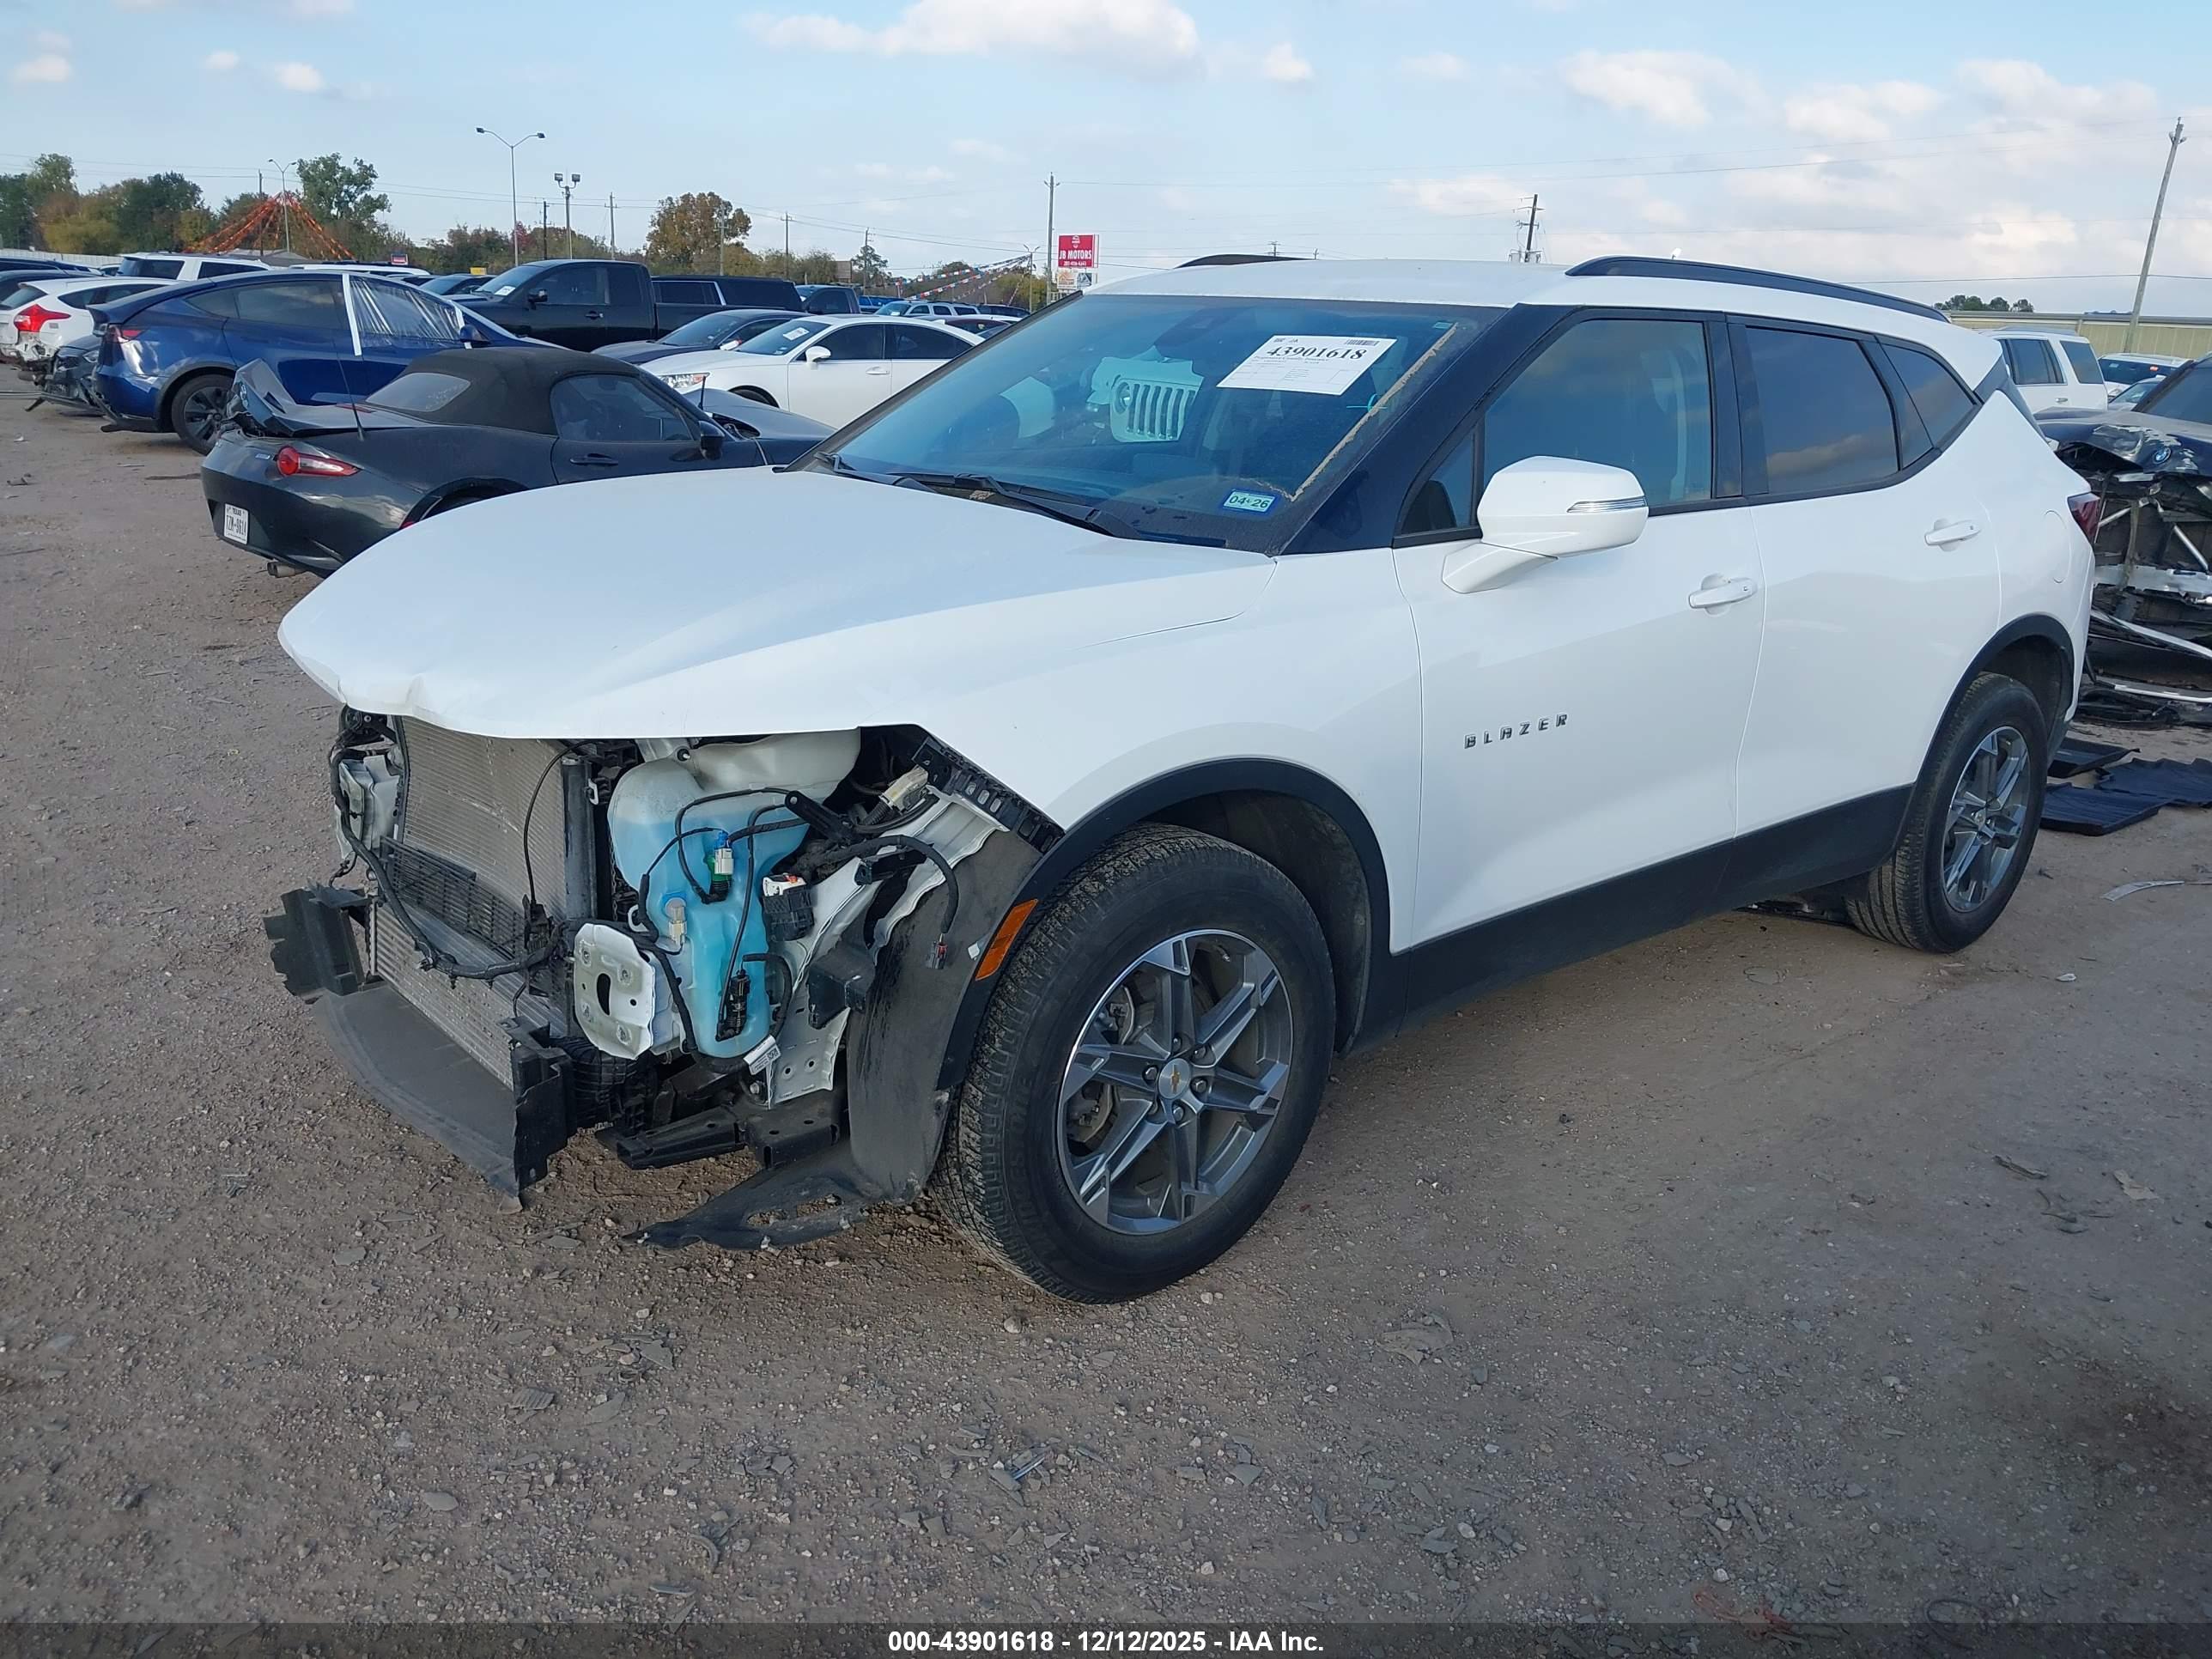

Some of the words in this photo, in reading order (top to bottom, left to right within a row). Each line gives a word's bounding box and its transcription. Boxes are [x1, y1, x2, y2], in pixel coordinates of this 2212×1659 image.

[1059, 250, 1066, 259] JB
[1067, 249, 1092, 260] MOTORS
[1267, 345, 1367, 361] 43901618
[232, 507, 241, 516] TEXAS
[1463, 713, 1567, 749] BLAZER
